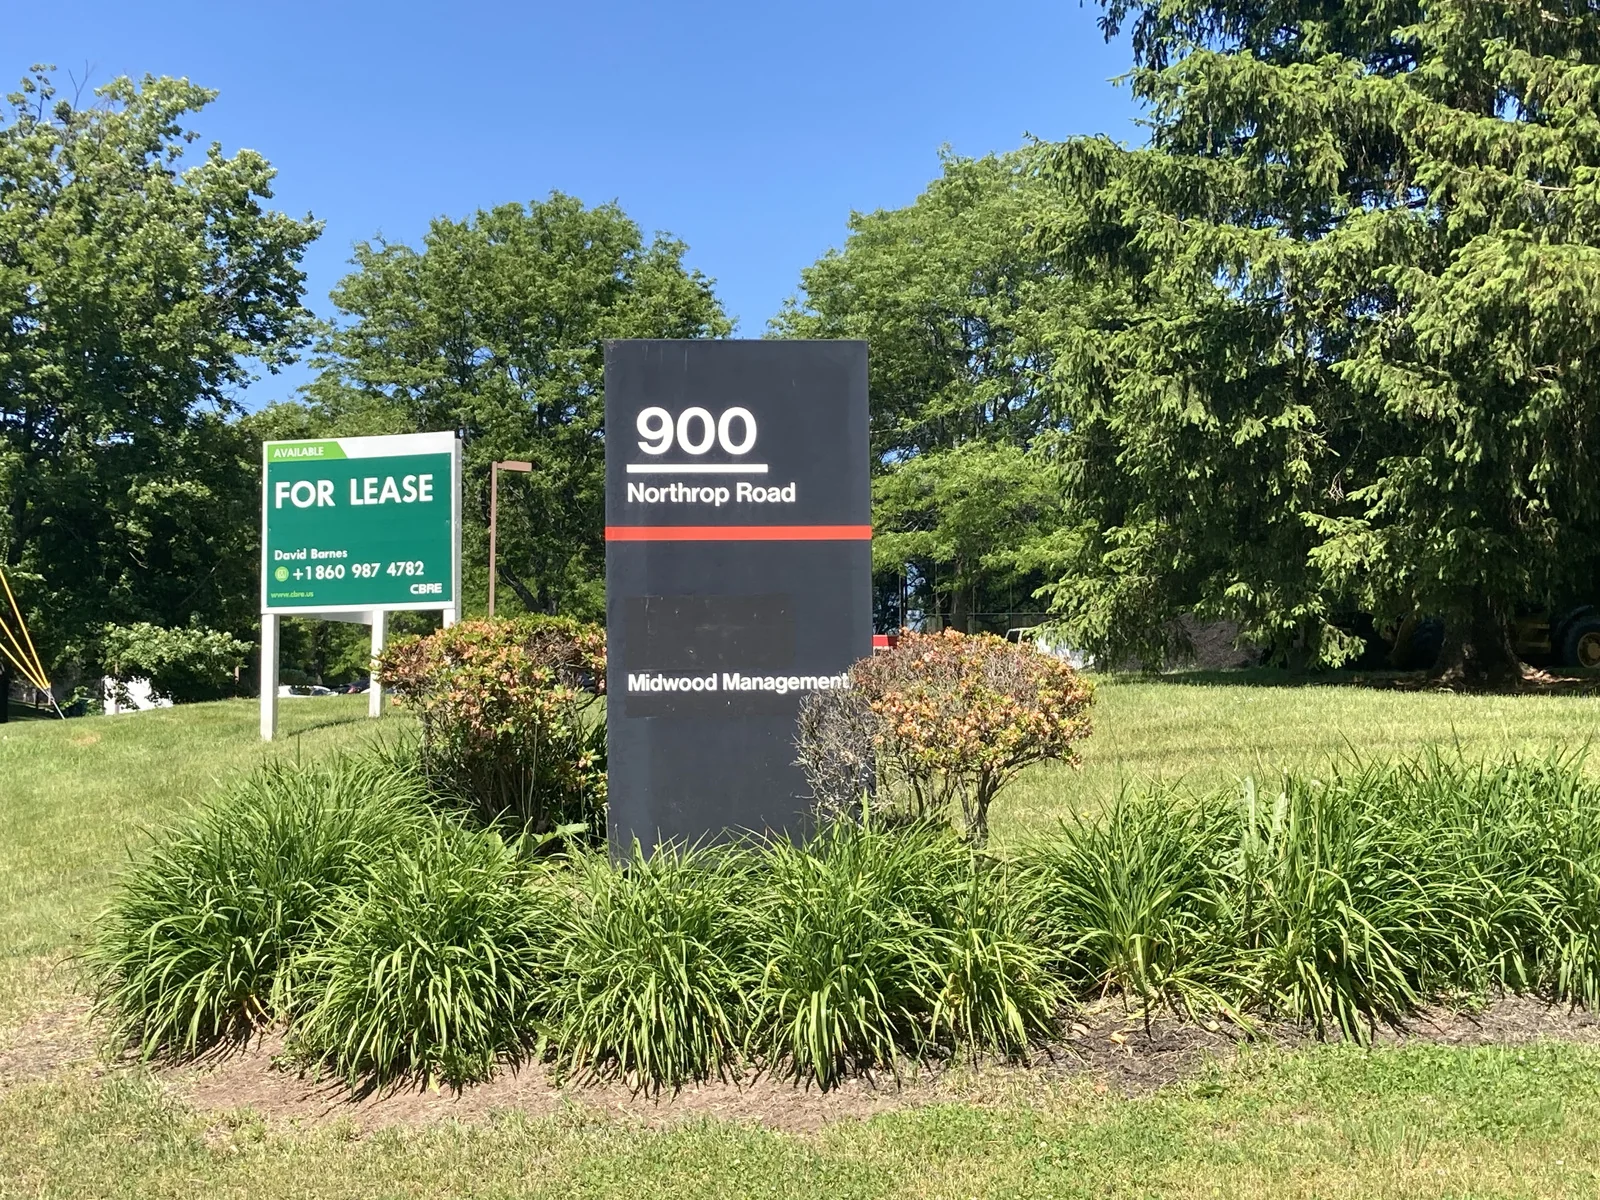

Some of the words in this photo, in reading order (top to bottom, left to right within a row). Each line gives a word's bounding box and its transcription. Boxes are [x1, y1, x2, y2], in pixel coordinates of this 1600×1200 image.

[636, 406, 757, 455] 900
[273, 446, 324, 458] AVAILABLE
[275, 480, 335, 509] FOR
[349, 474, 433, 506] LEASE
[627, 482, 730, 507] Northrop
[736, 481, 796, 503] Road
[274, 548, 307, 561] David
[311, 548, 348, 560] Barnes
[351, 562, 381, 578] 987
[386, 561, 424, 577] 4782
[270, 590, 314, 599] www.cbre.us
[410, 583, 442, 595] CBRE
[628, 673, 717, 692] Midwood
[722, 672, 850, 695] Management
